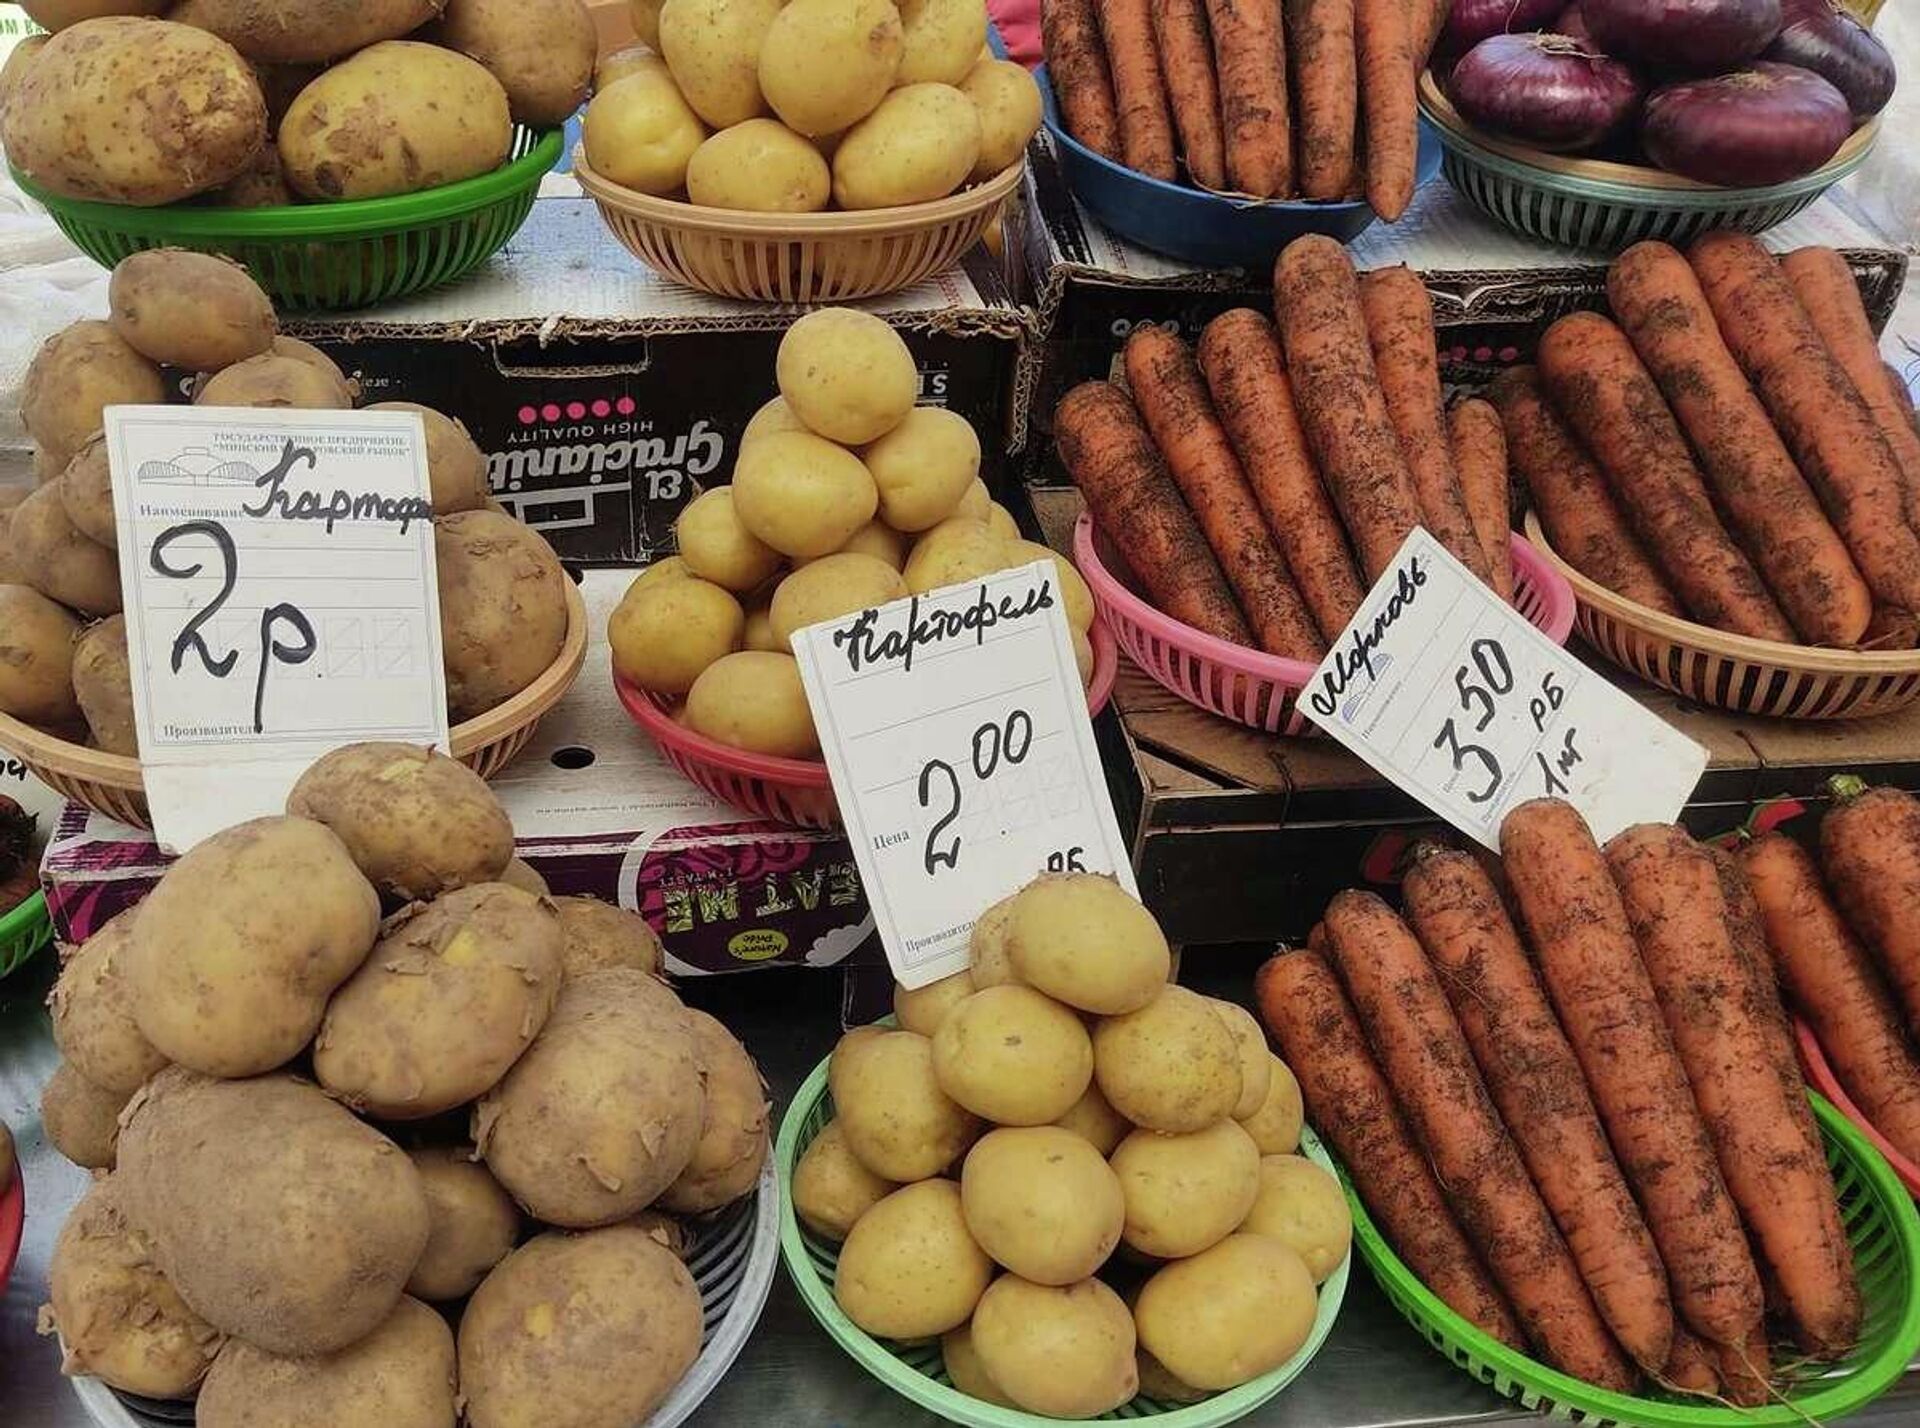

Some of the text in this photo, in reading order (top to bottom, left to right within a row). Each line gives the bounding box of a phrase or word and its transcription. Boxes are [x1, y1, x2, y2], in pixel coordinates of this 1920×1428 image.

[506, 421, 653, 444] HIGH QUALITY
[645, 468, 684, 500] El
[833, 579, 1054, 672] Картофель
[1311, 556, 1427, 716] Морковь
[164, 724, 262, 740] Производител
[873, 829, 911, 851] Цена
[664, 872, 741, 934] ME
